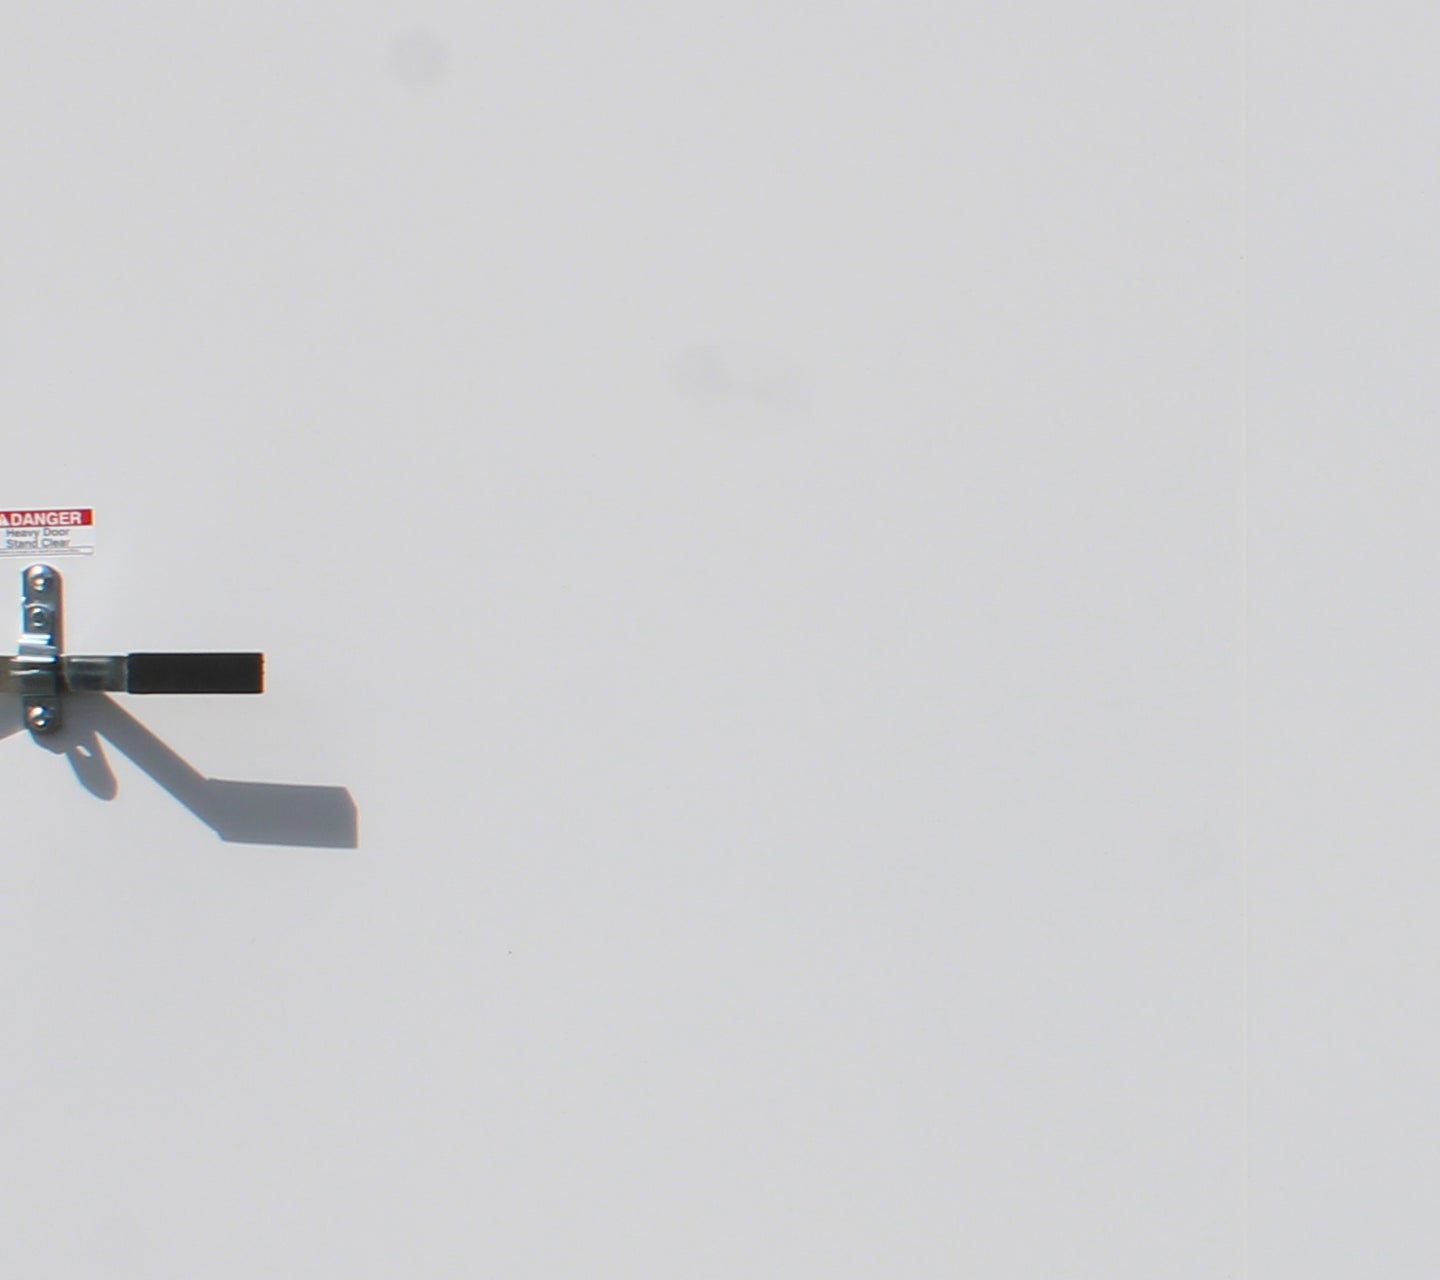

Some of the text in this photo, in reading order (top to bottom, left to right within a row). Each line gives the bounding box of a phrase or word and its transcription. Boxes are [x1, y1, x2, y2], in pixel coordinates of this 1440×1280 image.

[10, 511, 82, 527] DANGER
[6, 527, 70, 539] Heavy Door
[6, 538, 70, 549] Stand Clear
